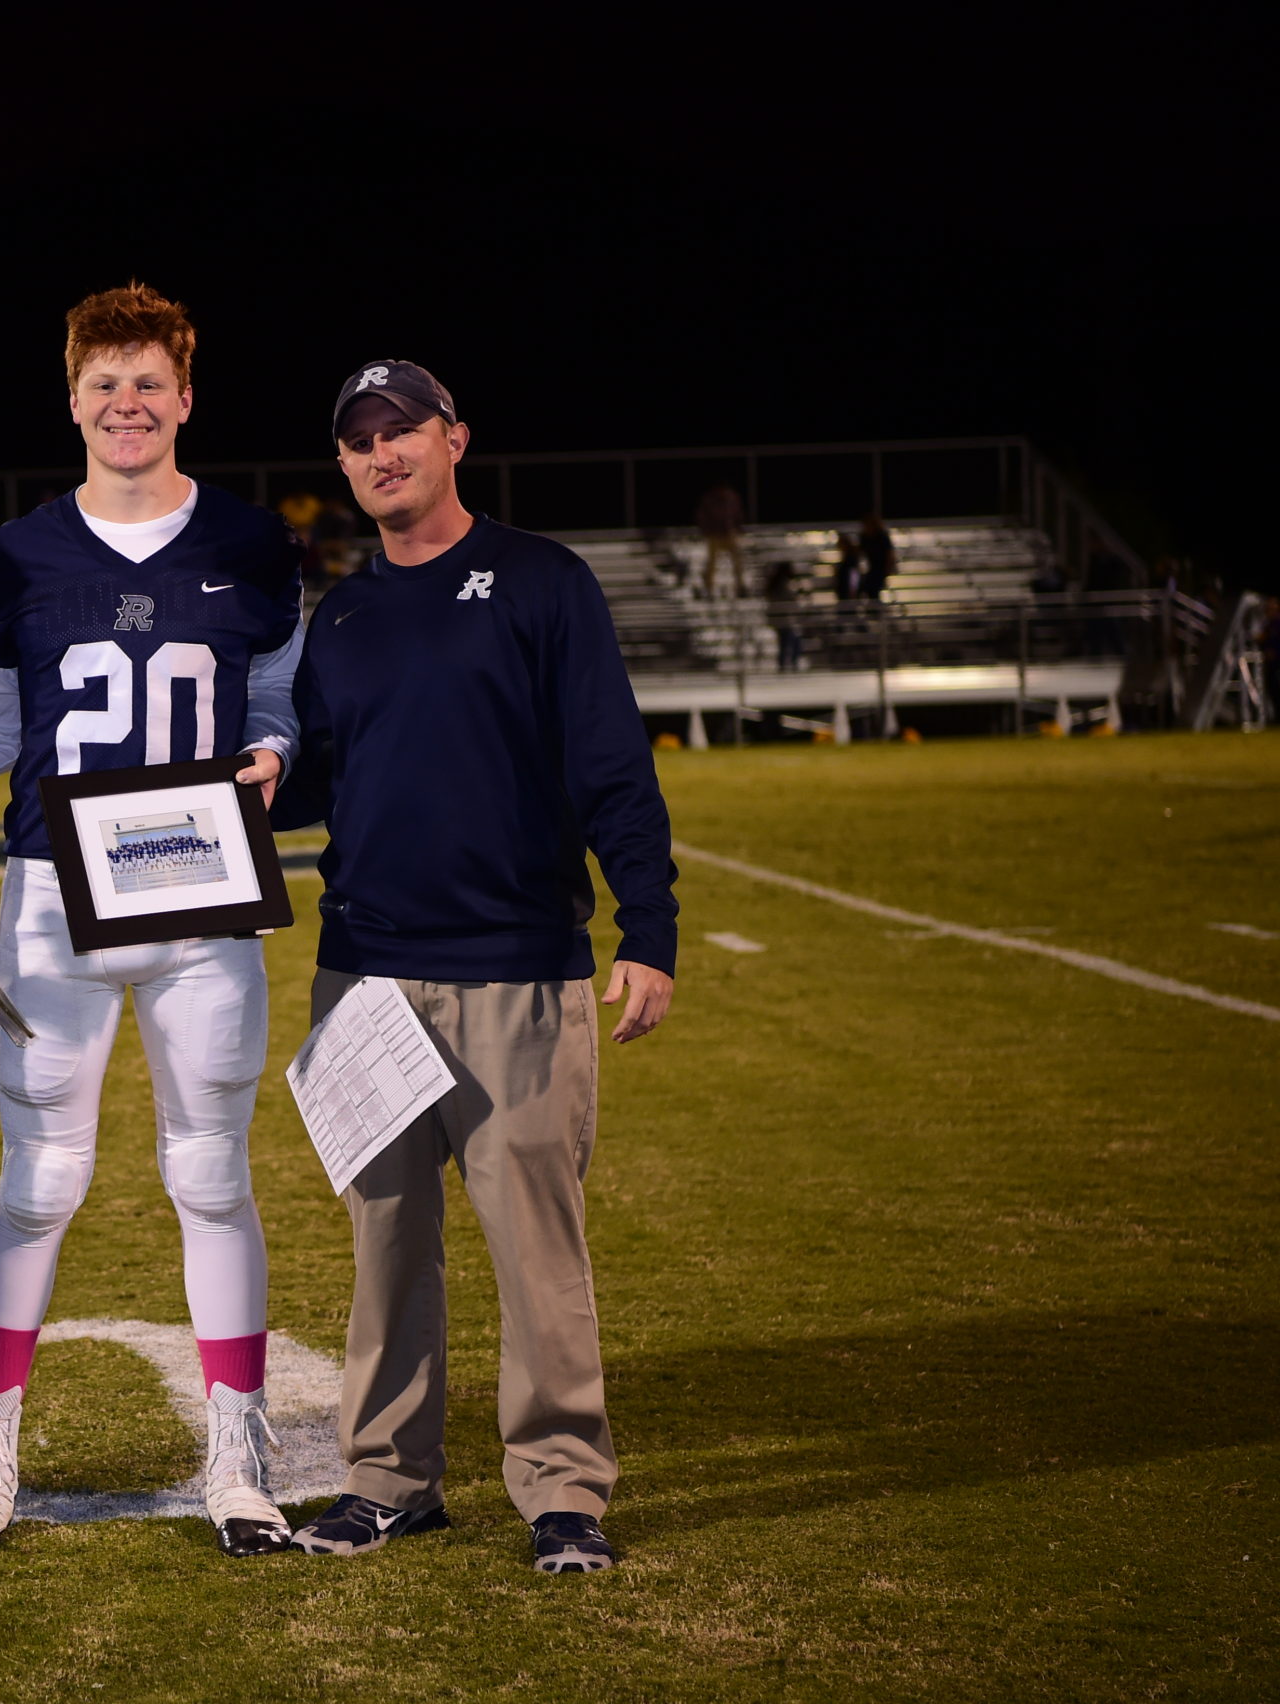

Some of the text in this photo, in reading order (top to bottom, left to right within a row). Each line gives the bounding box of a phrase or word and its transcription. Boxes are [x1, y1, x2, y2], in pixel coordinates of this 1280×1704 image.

[355, 366, 389, 392] R
[456, 570, 495, 600] R
[113, 594, 155, 632] R
[56, 640, 218, 775] 20
